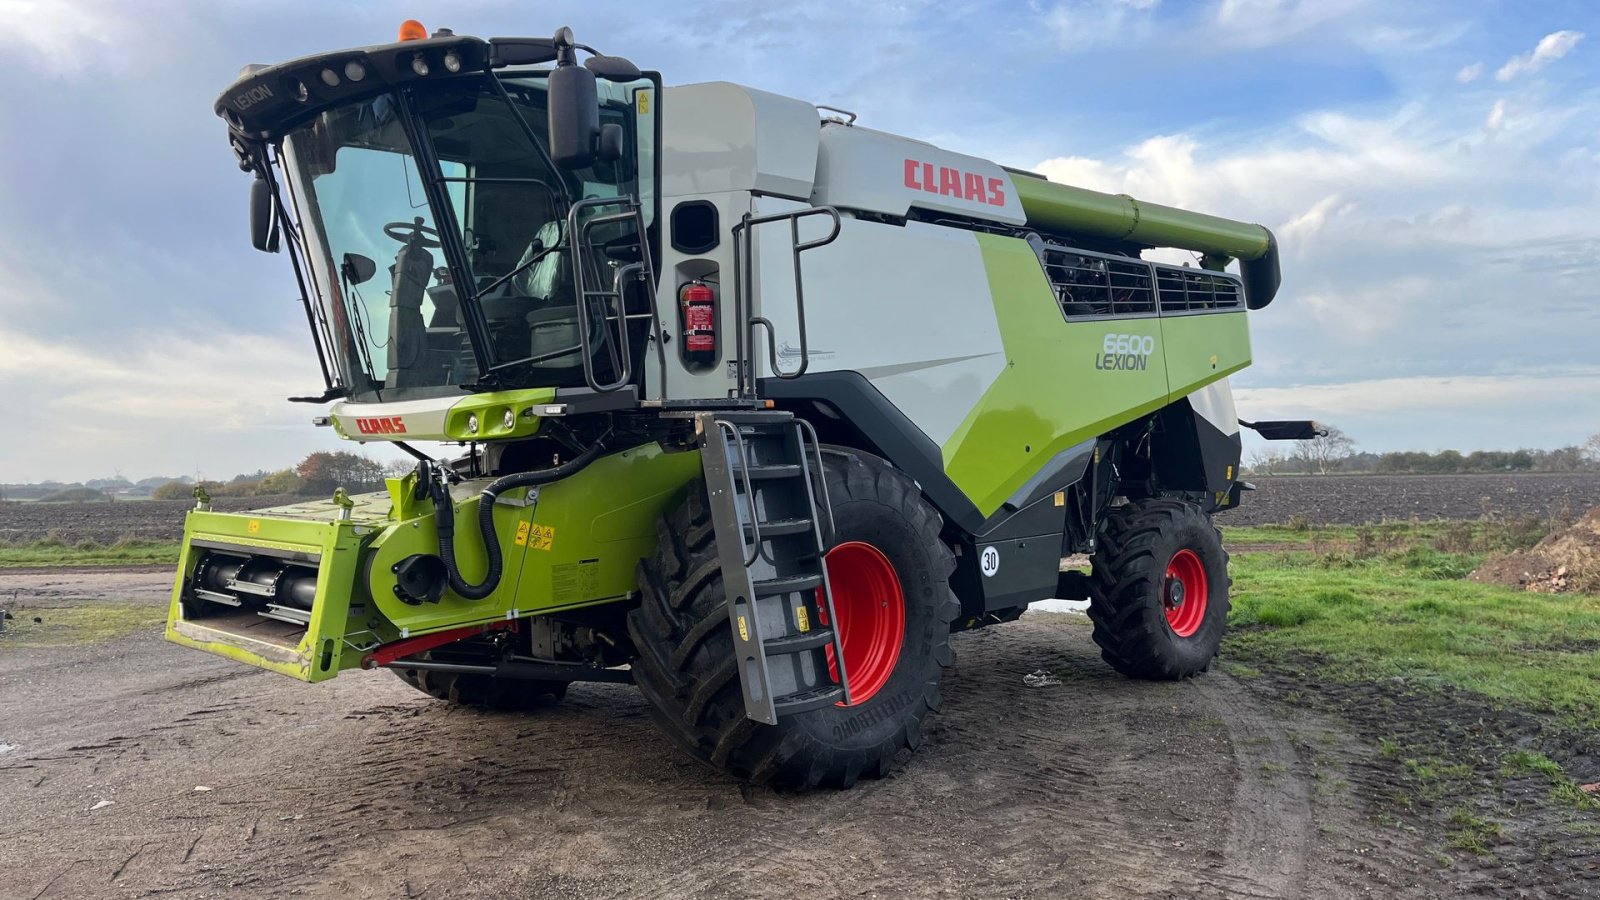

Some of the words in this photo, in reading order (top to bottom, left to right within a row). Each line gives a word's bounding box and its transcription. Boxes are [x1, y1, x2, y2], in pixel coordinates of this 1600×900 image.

[233, 84, 273, 110] LEXION
[904, 158, 1005, 206] CLAAS
[1103, 333, 1154, 356] 6600
[1096, 353, 1147, 370] LEXION
[356, 416, 407, 434] CLAAS
[984, 551, 996, 571] 30
[832, 690, 914, 743] TRELLEBORG
